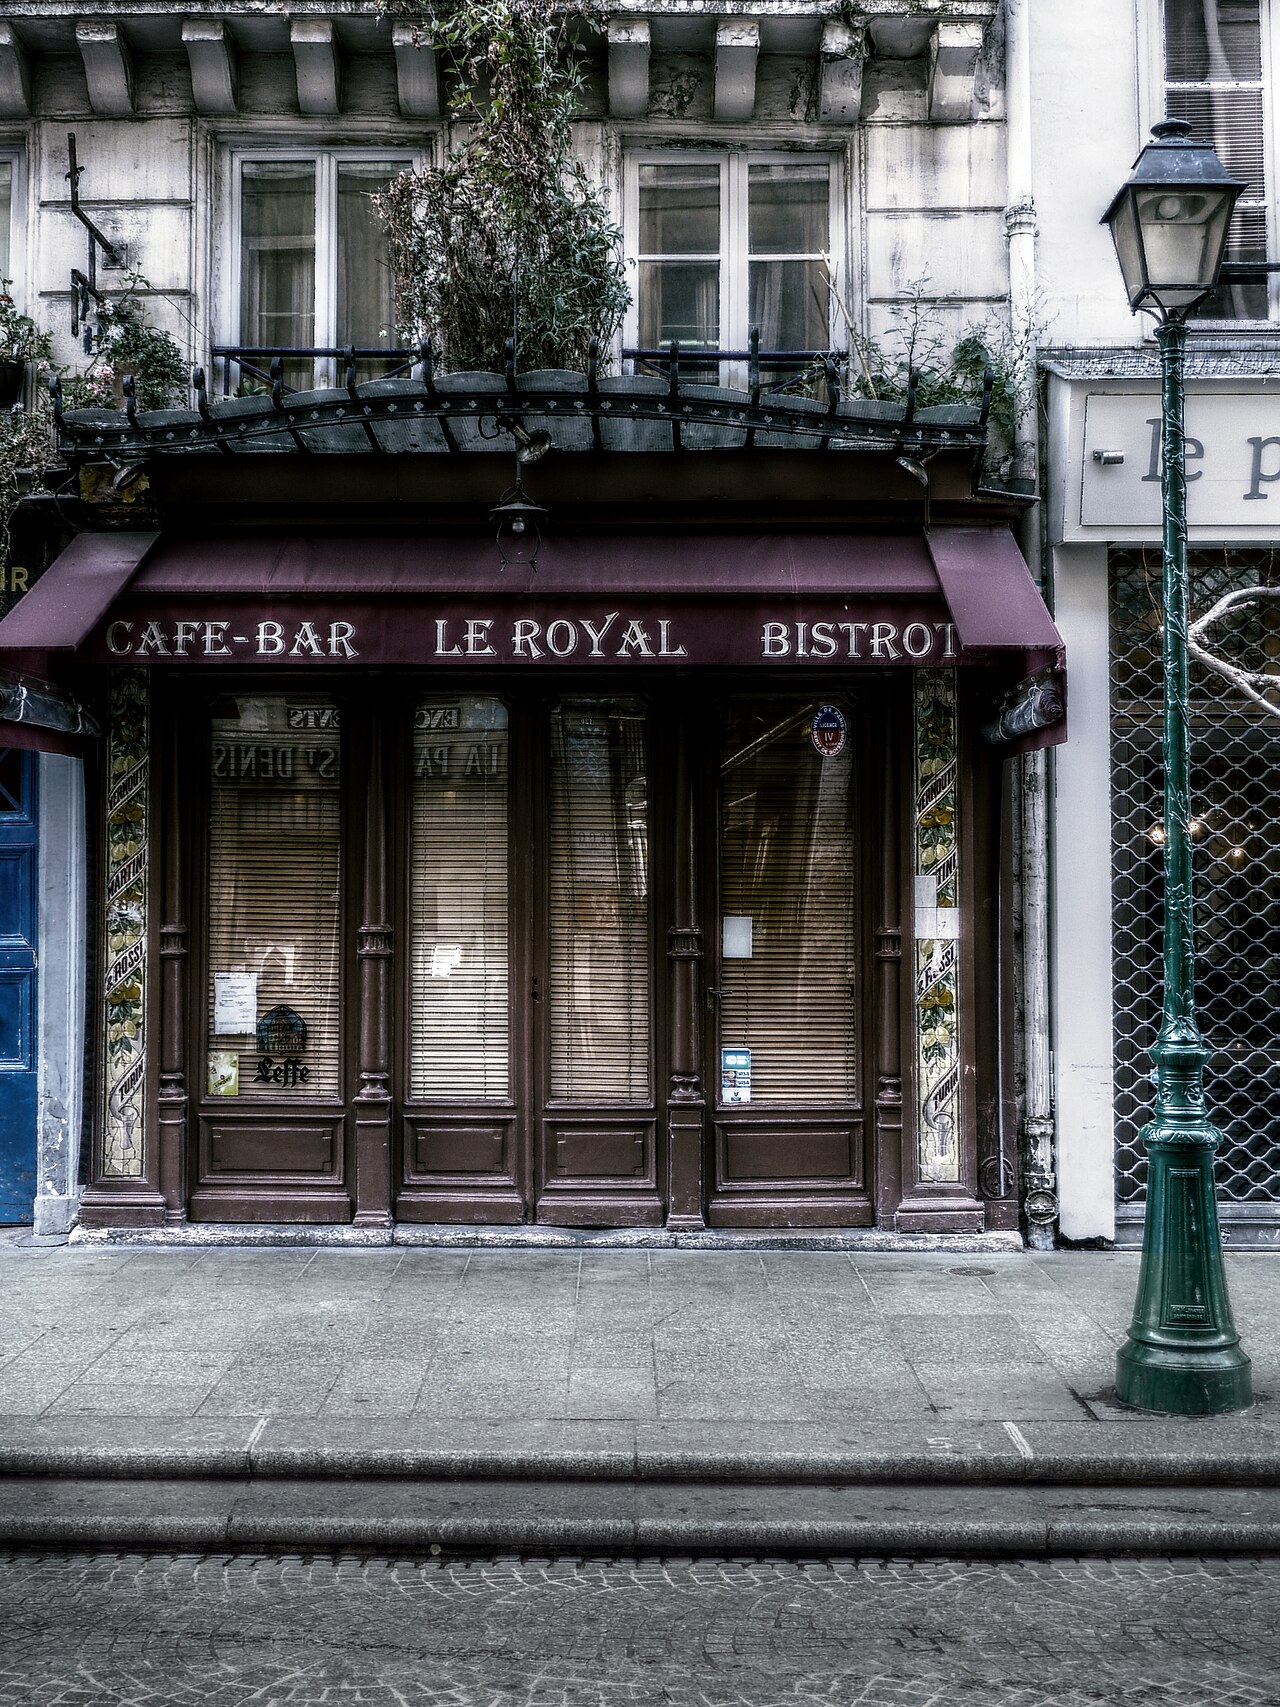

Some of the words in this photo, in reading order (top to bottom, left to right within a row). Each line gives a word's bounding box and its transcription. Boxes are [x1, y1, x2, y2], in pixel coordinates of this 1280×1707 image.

[105, 620, 360, 660] CAFE-BAR
[433, 619, 497, 657] LE
[511, 610, 688, 660] ROYAL
[760, 621, 958, 661] BISTROT
[824, 732, 834, 742] IV
[109, 762, 147, 812] VERMOUTH
[918, 761, 957, 815] VERMOUTH
[107, 848, 146, 901] MARTINI
[114, 940, 144, 983] ROSSI
[118, 1058, 144, 1102] TURIN
[252, 1055, 311, 1088] Leffe
[933, 1066, 958, 1112] TURIN
